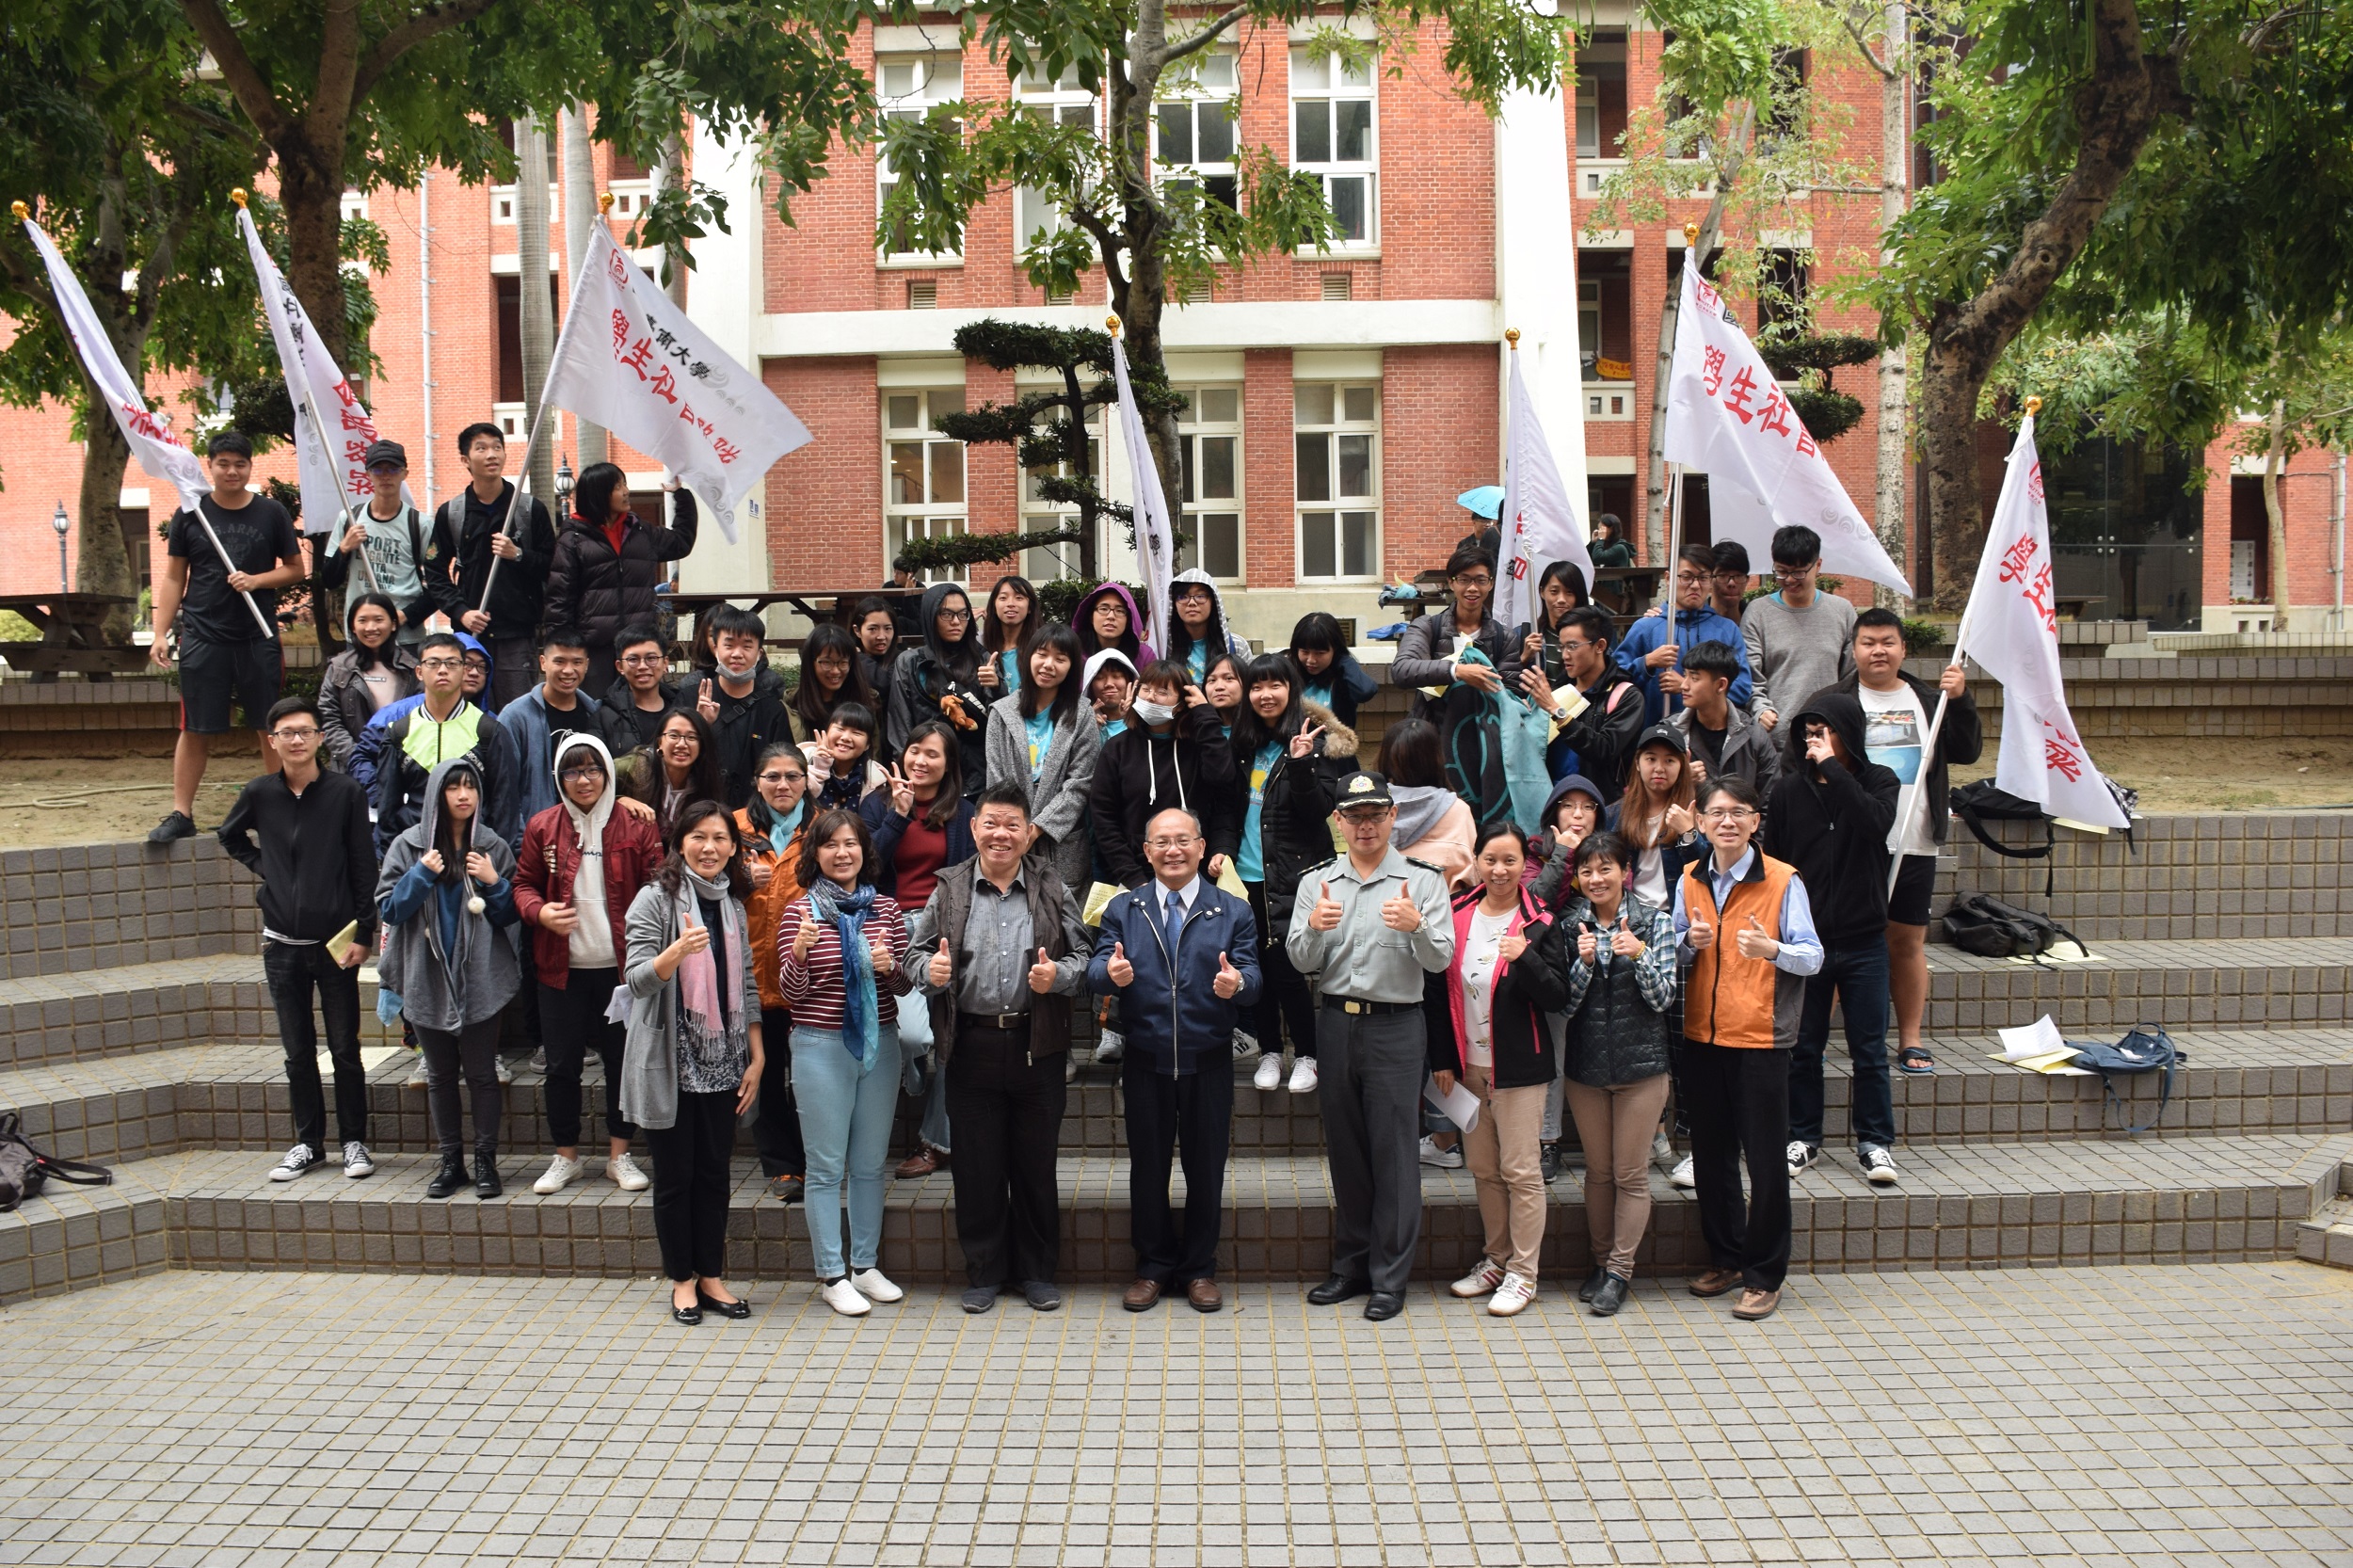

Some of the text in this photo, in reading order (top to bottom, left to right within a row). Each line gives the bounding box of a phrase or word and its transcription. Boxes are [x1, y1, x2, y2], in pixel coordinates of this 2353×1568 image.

[199, 522, 265, 543] S.ARMY
[362, 535, 402, 553] PORT
[370, 561, 387, 574] ITA
